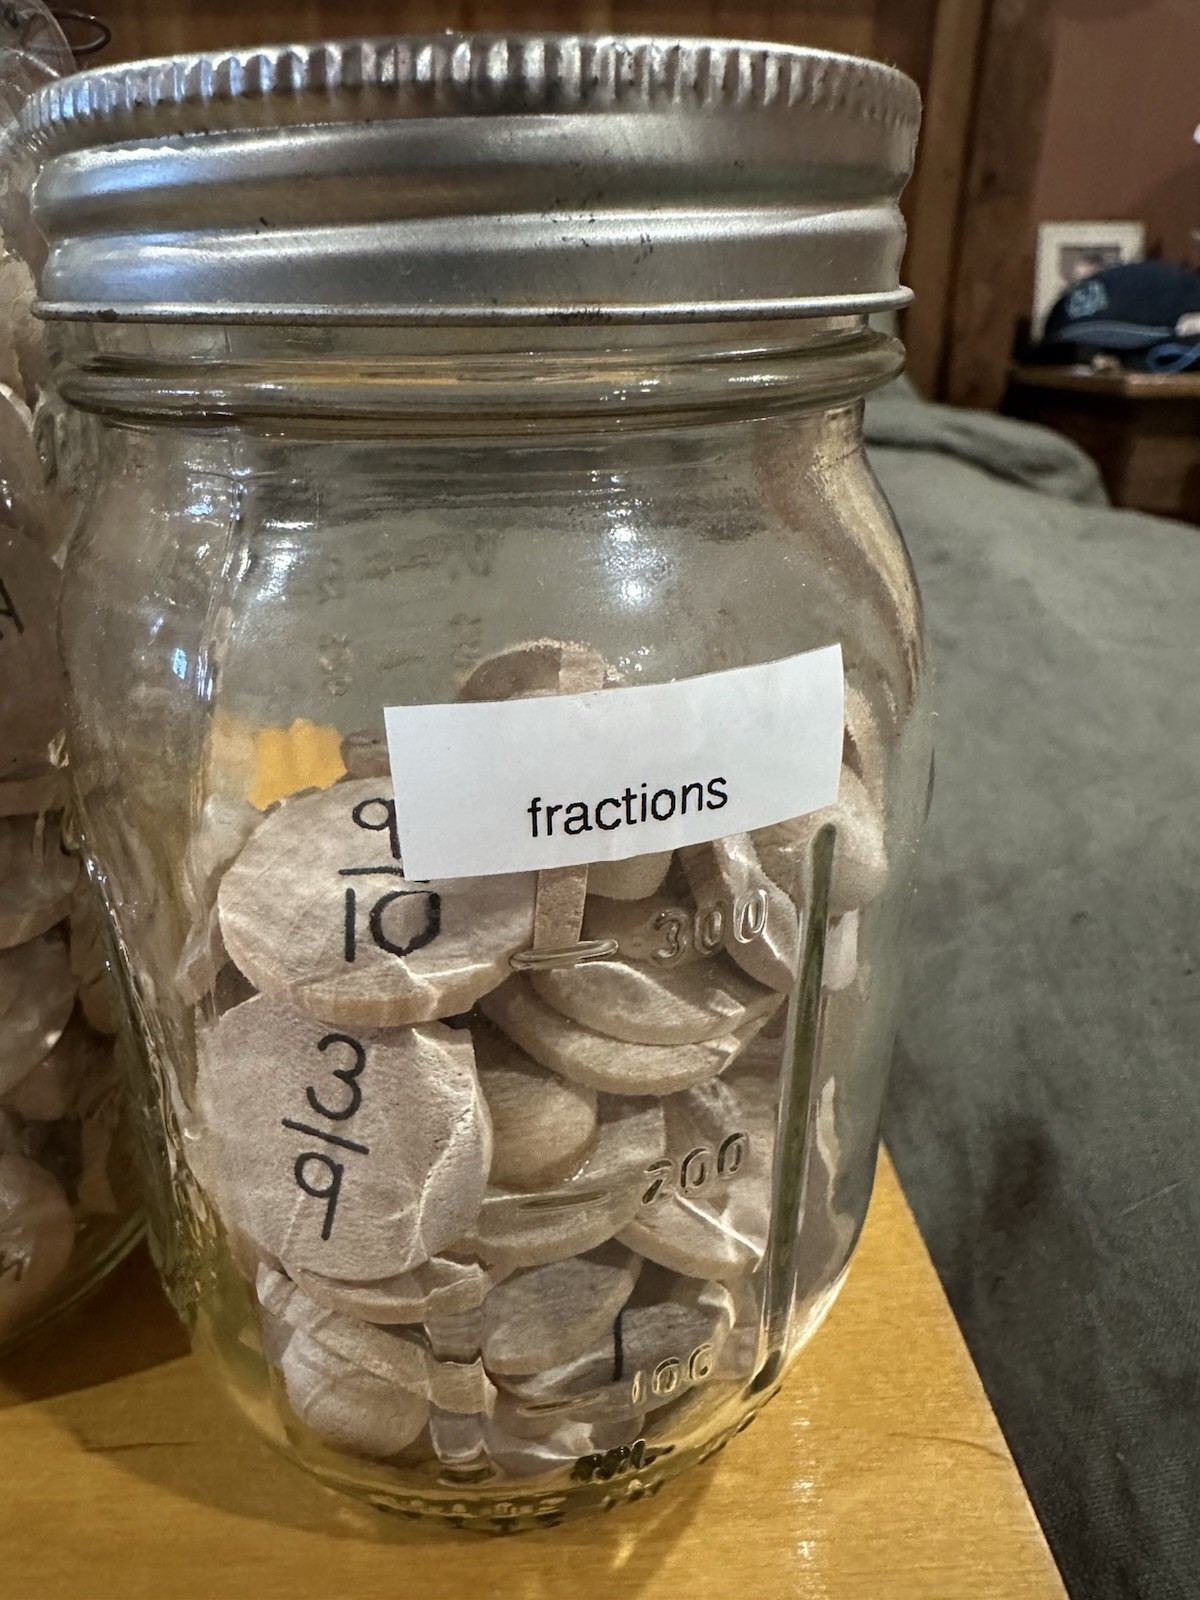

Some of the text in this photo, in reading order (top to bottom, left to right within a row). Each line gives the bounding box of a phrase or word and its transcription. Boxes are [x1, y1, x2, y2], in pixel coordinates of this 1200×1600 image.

[352, 797, 401, 860] 9
[528, 777, 729, 838] fractions
[346, 886, 441, 962] 10
[652, 889, 768, 967] 300
[641, 1131, 748, 1206] 200
[631, 1343, 714, 1405] 100
